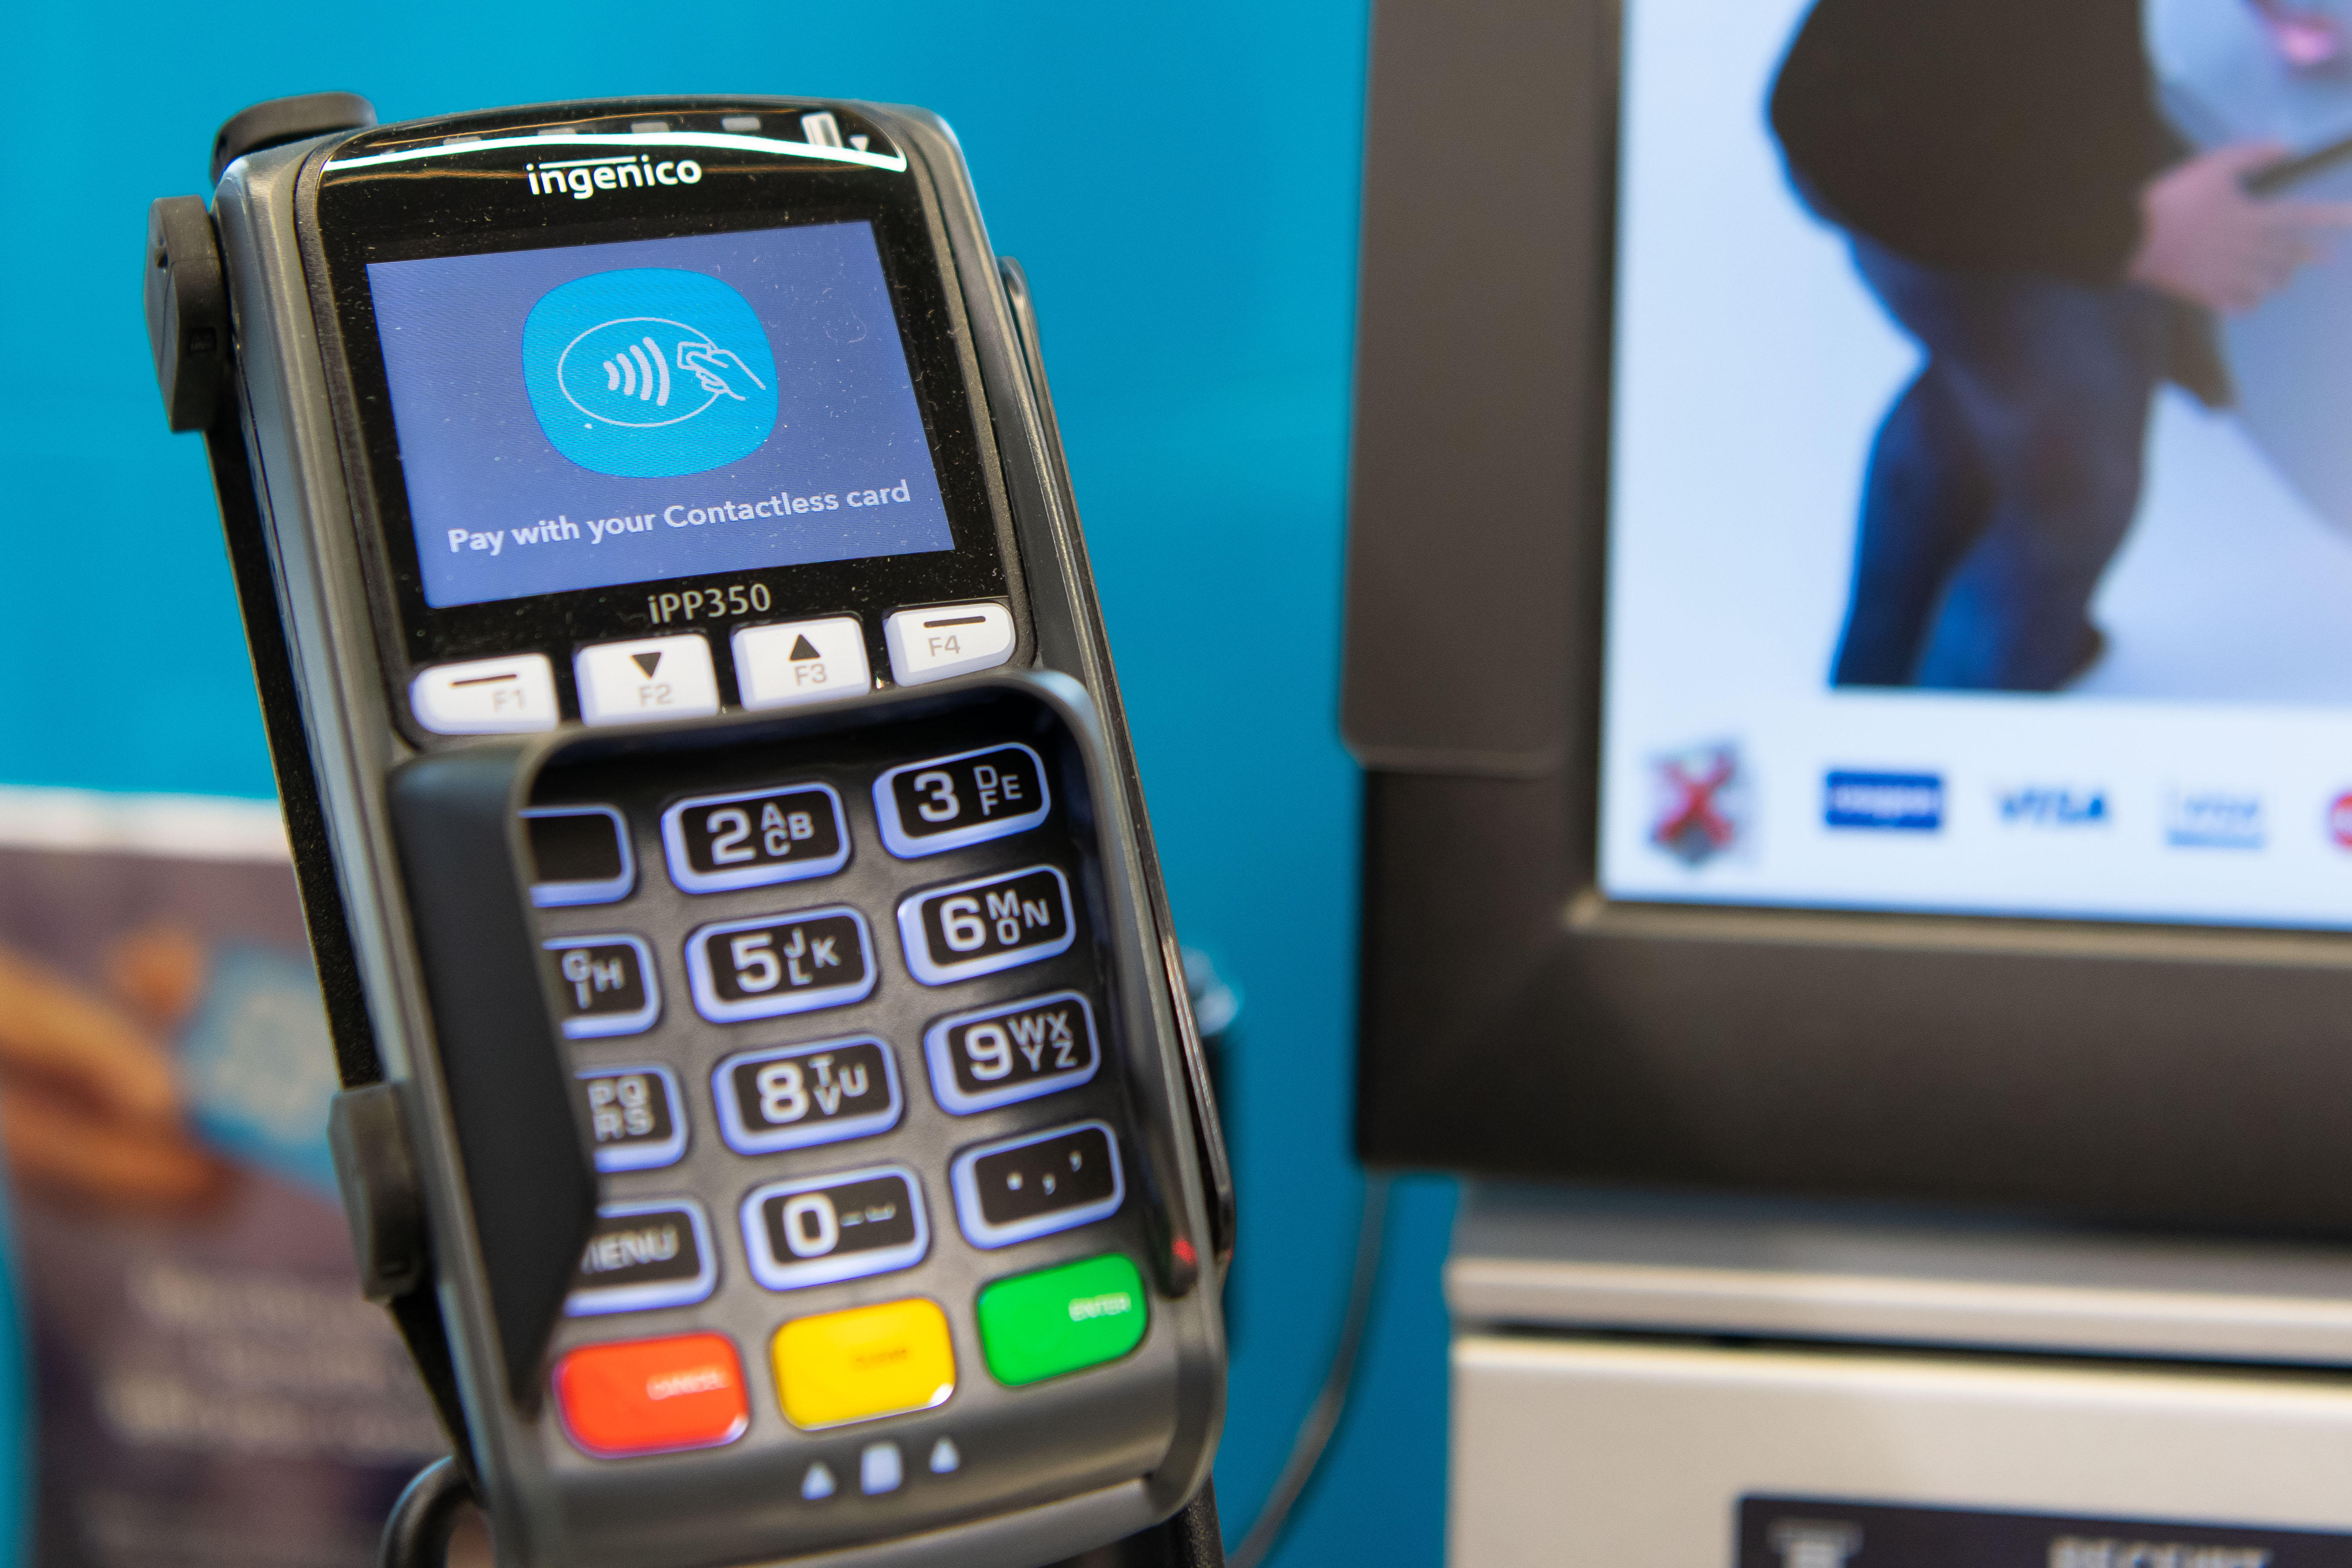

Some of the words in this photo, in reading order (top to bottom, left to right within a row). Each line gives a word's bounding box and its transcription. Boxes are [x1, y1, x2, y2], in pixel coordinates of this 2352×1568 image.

[526, 153, 702, 200] ingenico
[447, 528, 504, 556] Pay
[511, 515, 580, 545] with
[586, 513, 656, 544] your
[663, 492, 839, 528] Contactless
[846, 479, 911, 507] card
[647, 583, 771, 624] iPP350
[927, 635, 961, 657] F4
[492, 687, 526, 712] F1
[638, 683, 673, 707] F2
[794, 664, 827, 687] F3
[913, 771, 960, 822] 3
[706, 807, 757, 865] 2
[939, 895, 987, 952] 6
[729, 931, 782, 993] 5
[964, 1022, 1013, 1081] 9
[755, 1061, 810, 1125] 8
[782, 1192, 838, 1258] 0
